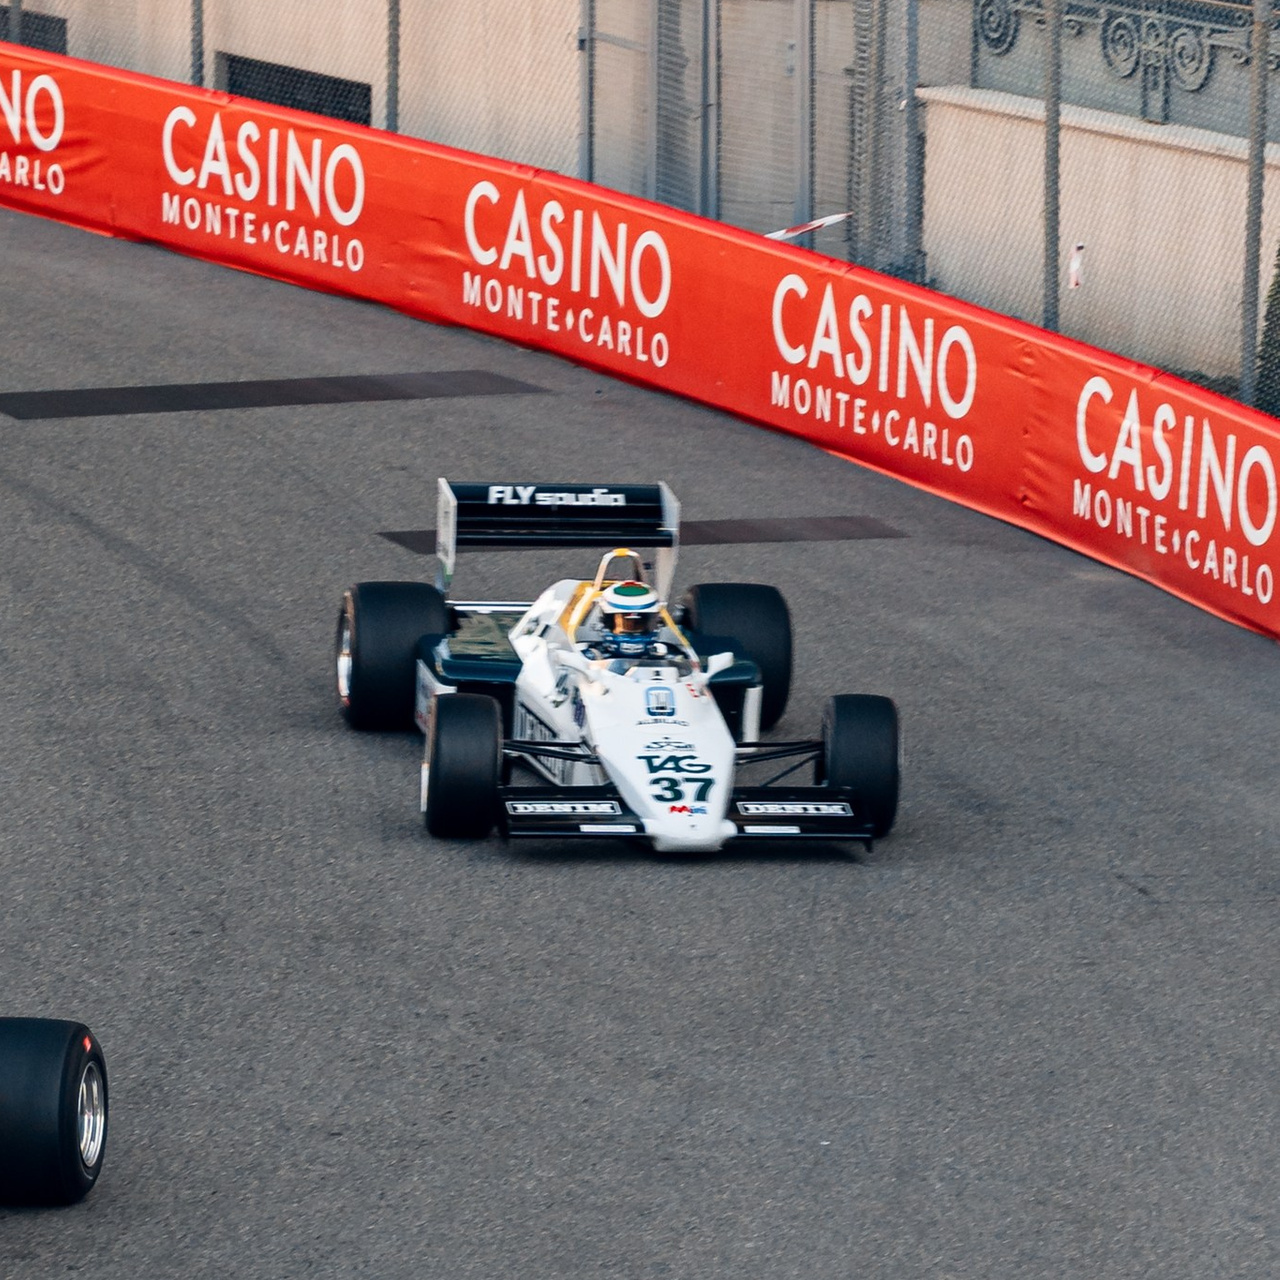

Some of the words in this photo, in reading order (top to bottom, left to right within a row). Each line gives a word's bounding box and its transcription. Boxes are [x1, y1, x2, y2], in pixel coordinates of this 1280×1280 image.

[162, 106, 364, 225] CASINO
[465, 181, 671, 318] CASINO
[772, 274, 977, 419] CASINO
[488, 486, 536, 505] FLY
[1077, 376, 1277, 546] CASINO
[636, 754, 712, 773] TAG
[650, 777, 715, 802] 37
